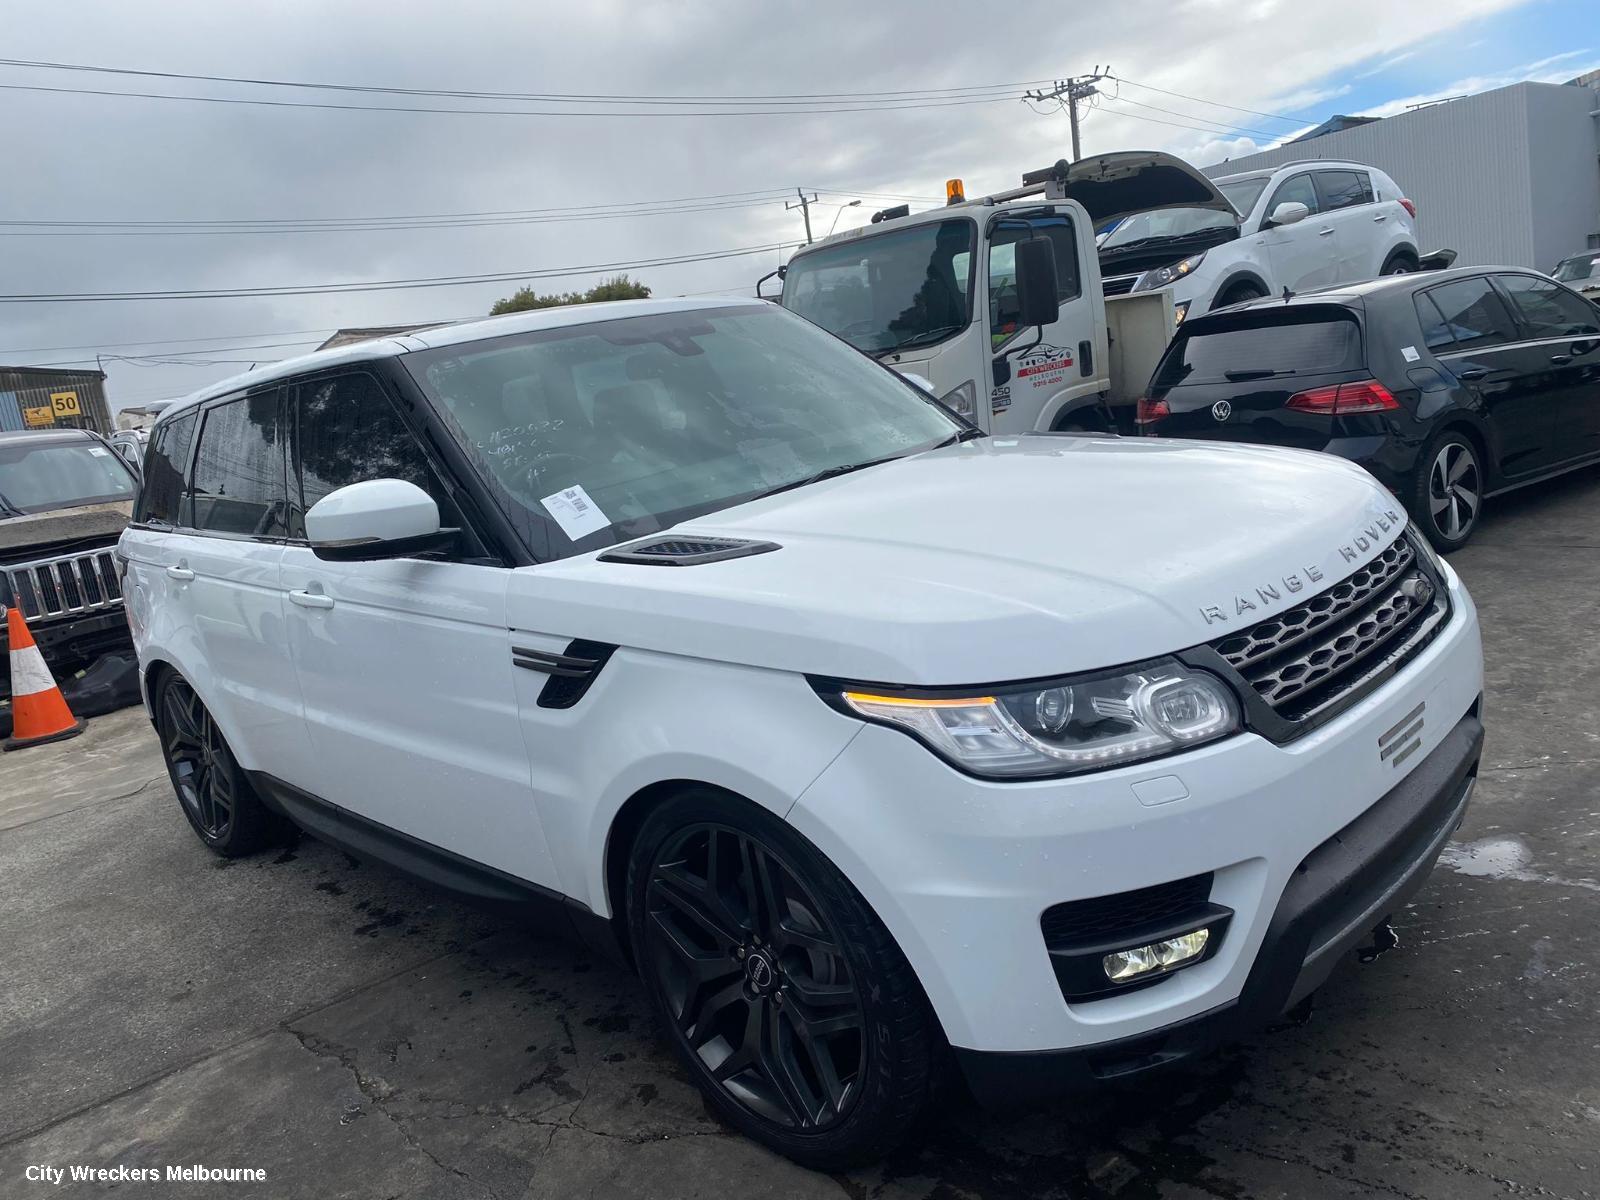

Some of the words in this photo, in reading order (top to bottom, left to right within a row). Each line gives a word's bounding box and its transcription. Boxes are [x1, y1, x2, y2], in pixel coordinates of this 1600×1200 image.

[991, 387, 1010, 397] 450
[55, 397, 76, 411] 50
[1199, 564, 1324, 625] RANGE
[1337, 510, 1400, 563] ROVER
